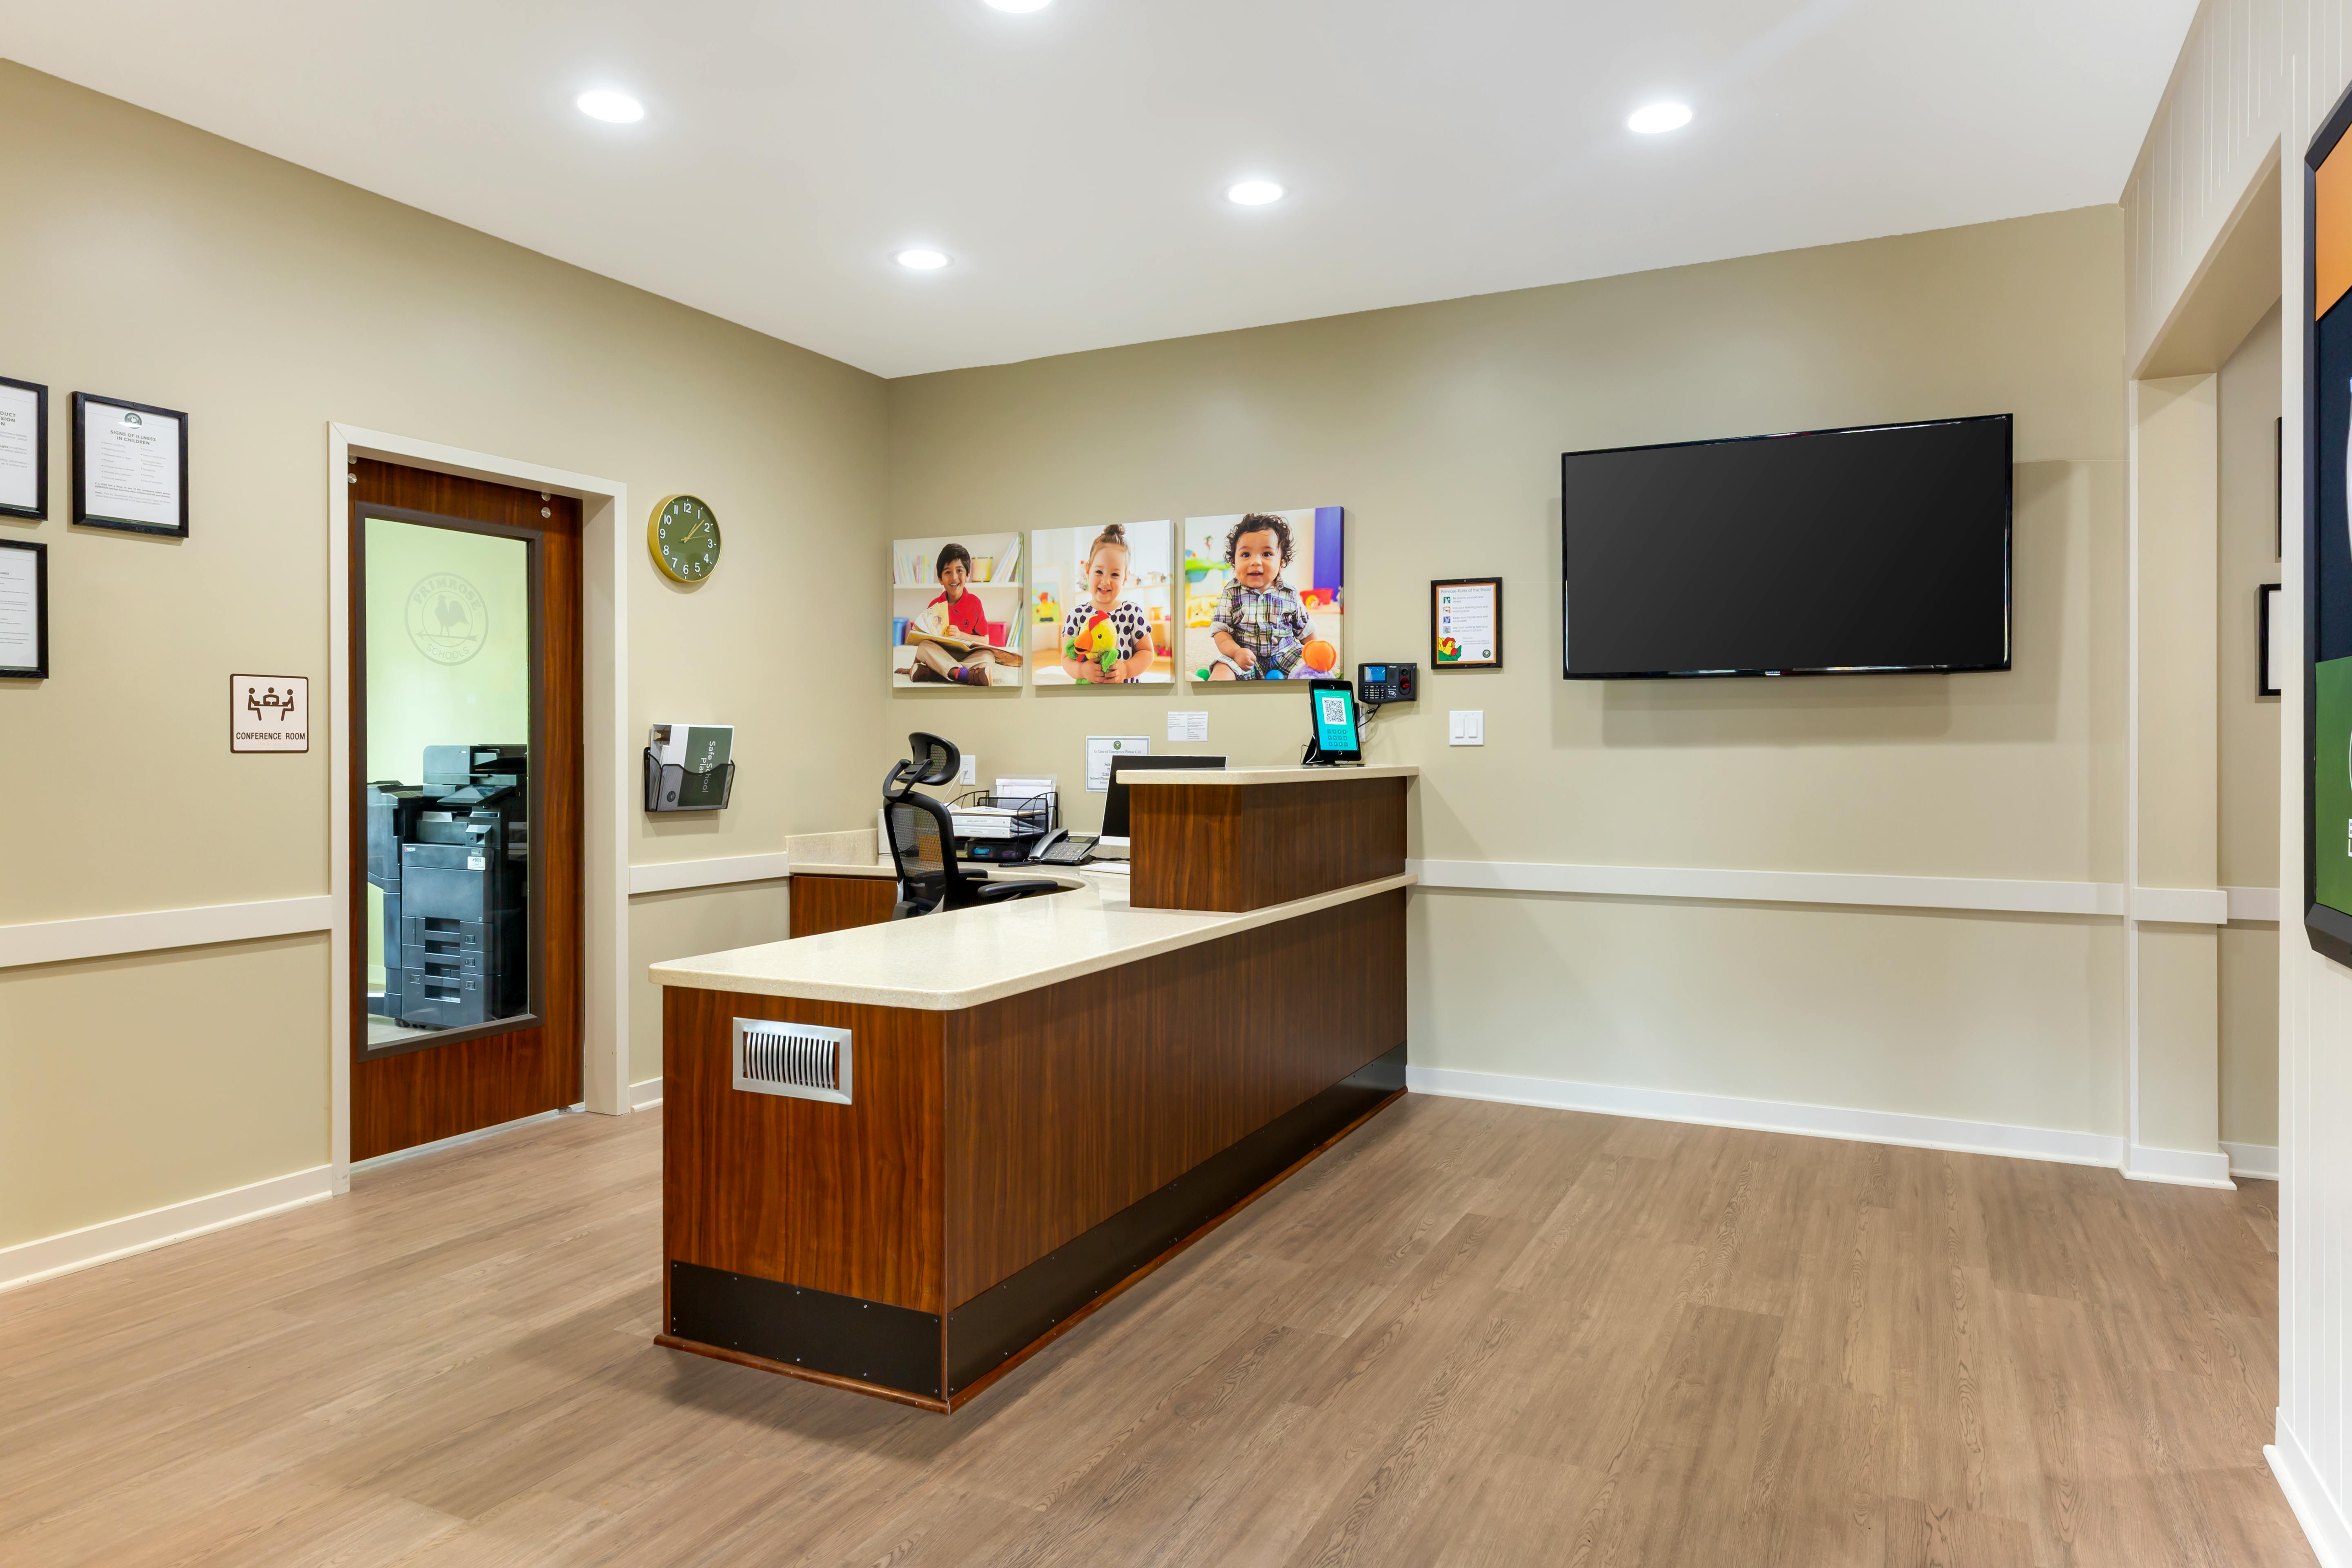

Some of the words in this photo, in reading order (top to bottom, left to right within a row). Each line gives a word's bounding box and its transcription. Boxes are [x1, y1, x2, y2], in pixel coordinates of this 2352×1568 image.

[674, 505, 678, 515] 11
[684, 502, 691, 513] 12
[664, 514, 672, 525] 10
[698, 509, 700, 519] 1
[704, 522, 710, 532] 2
[659, 528, 666, 539] 9
[707, 539, 713, 548] 3
[663, 545, 669, 555] 8
[672, 557, 677, 568] 7
[704, 553, 709, 563] 4
[683, 564, 688, 575] 6
[695, 562, 700, 572] 5
[413, 578, 481, 610] PRIMROSE
[426, 644, 469, 659] SCHOOLS
[707, 741, 716, 760] Safe
[702, 763, 713, 793] School
